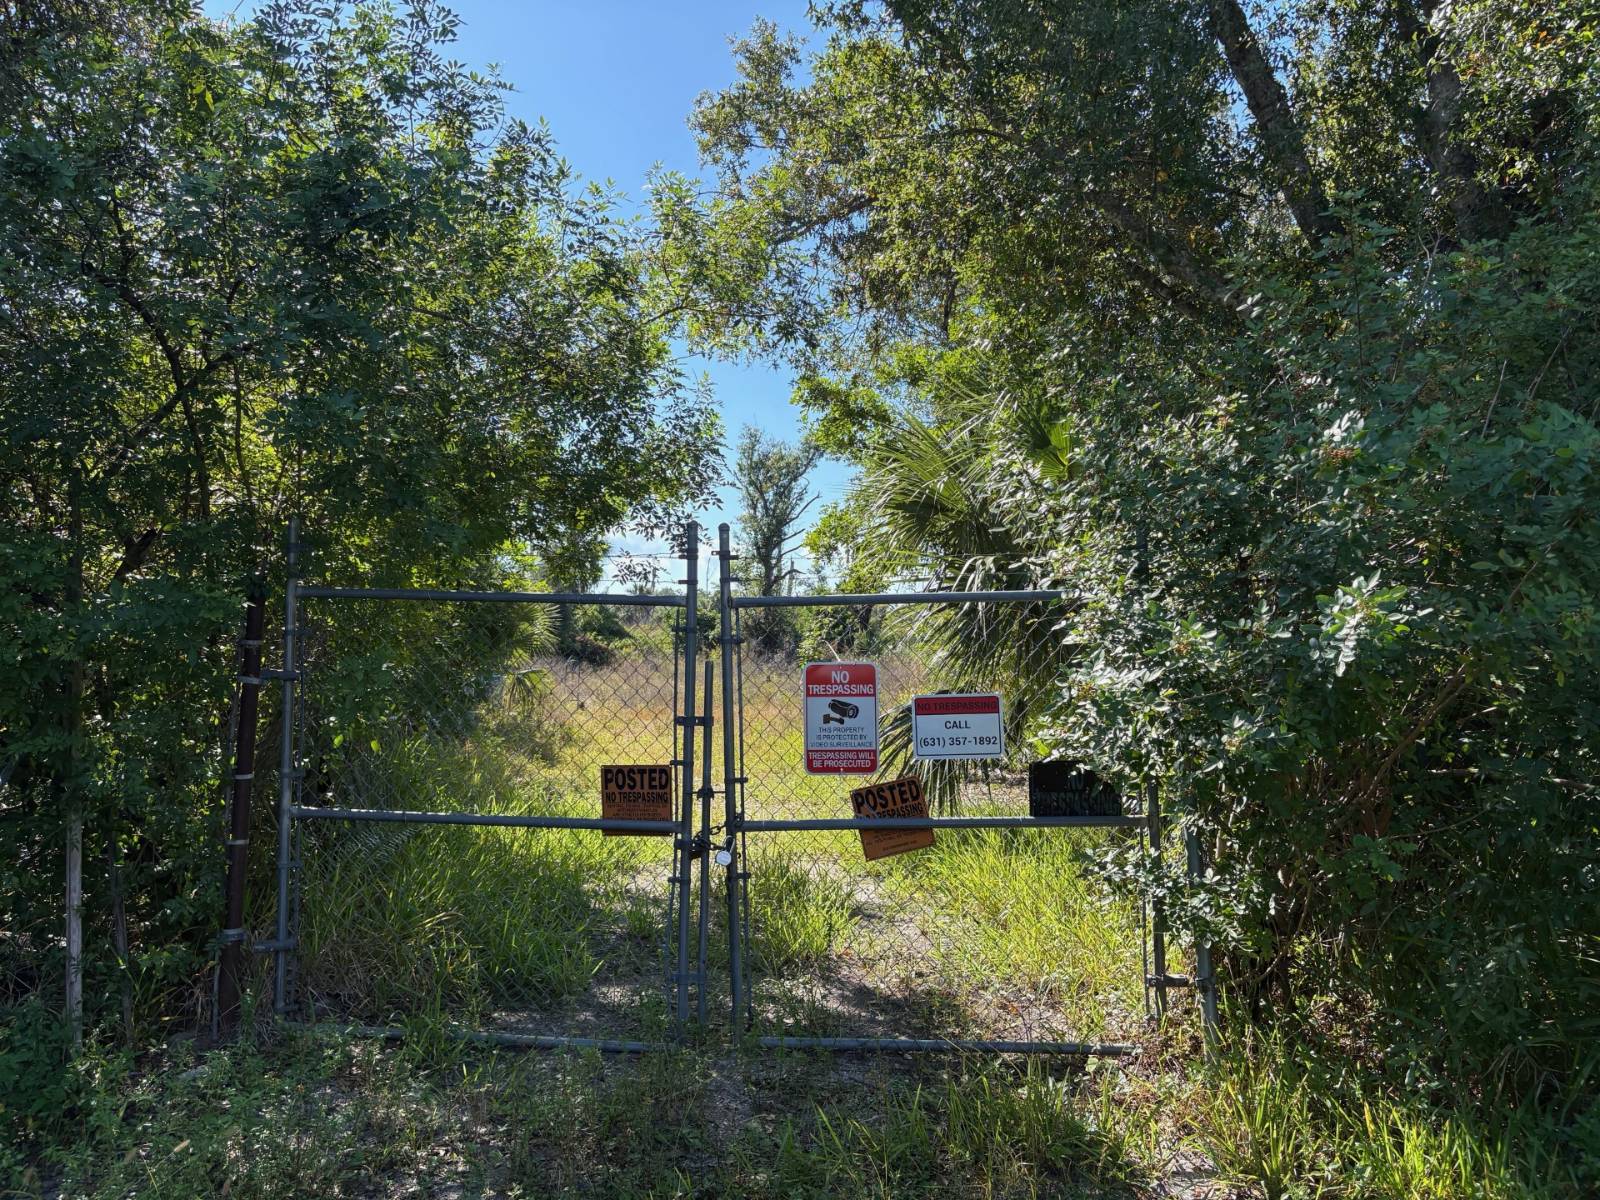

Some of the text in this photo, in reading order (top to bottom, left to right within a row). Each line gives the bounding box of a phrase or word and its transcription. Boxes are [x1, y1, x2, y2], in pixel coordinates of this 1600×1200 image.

[832, 670, 849, 684] NO
[808, 684, 874, 695] TRESPASSING
[917, 701, 997, 711] NO TRESPASSING
[944, 720, 971, 730] CALL
[919, 736, 998, 748] (631) 357-1892
[808, 752, 858, 760] TRESPASSING
[813, 760, 871, 768] BE PROSECUTED
[604, 768, 669, 790] POSTED
[606, 791, 669, 803] NO TRESPASSING
[853, 780, 920, 814] POSTED
